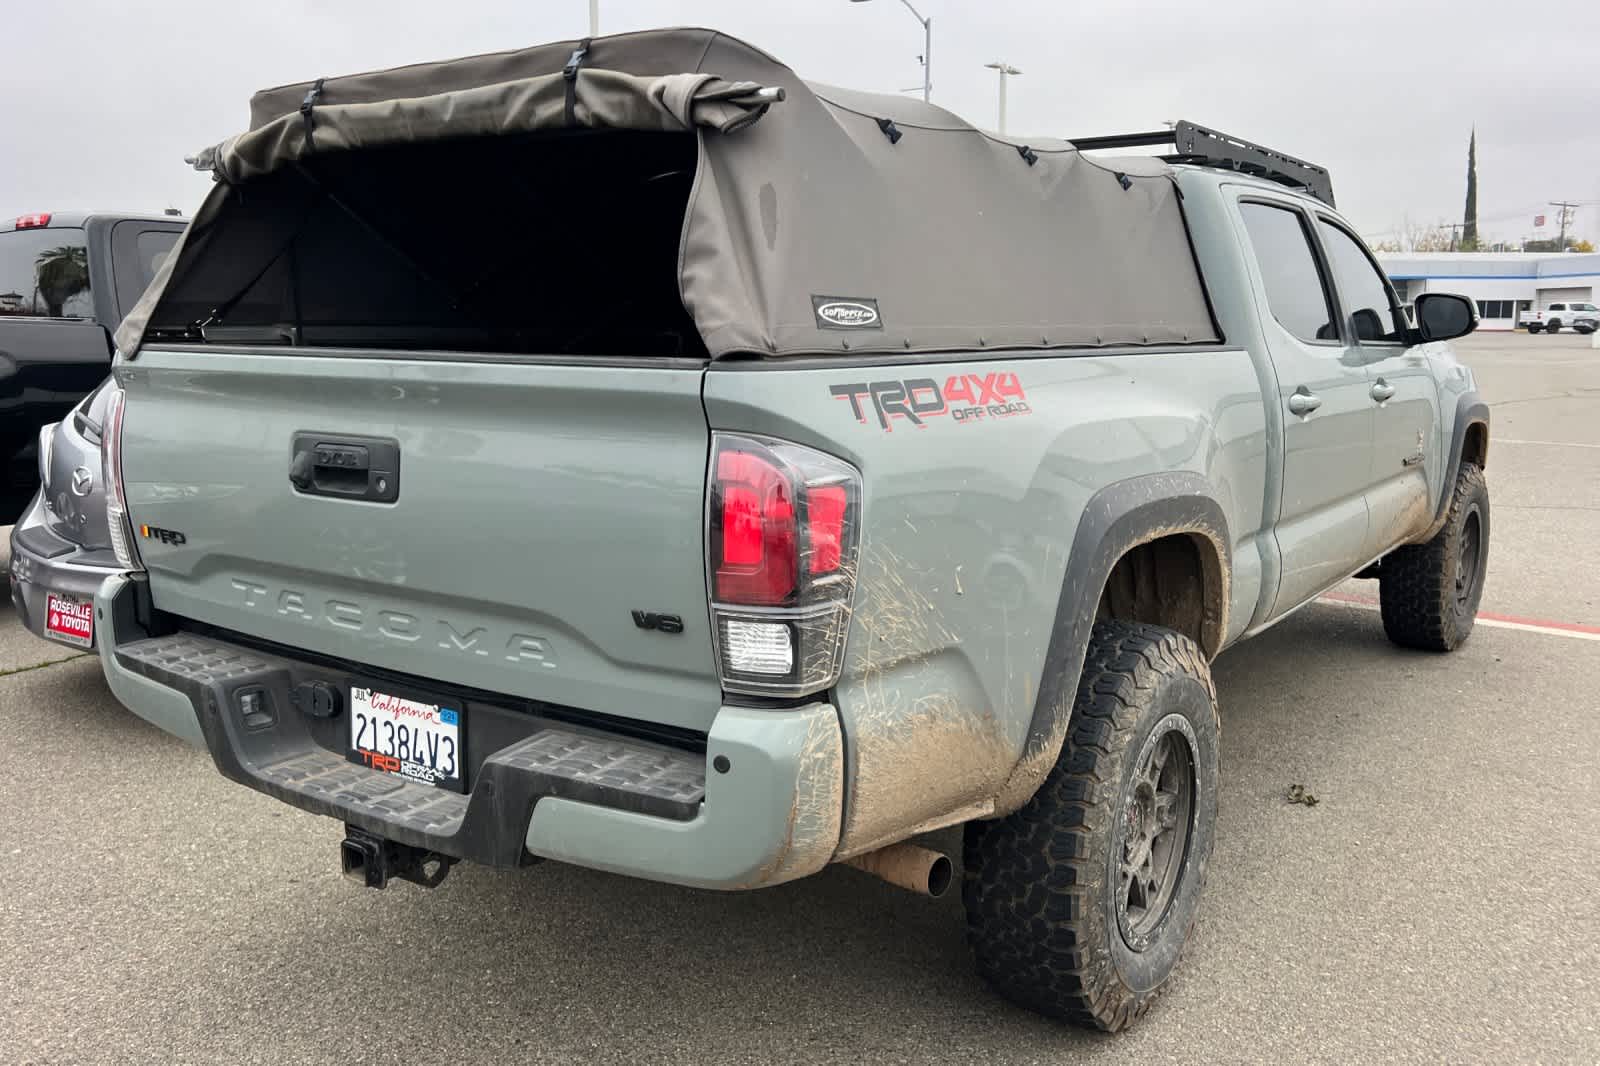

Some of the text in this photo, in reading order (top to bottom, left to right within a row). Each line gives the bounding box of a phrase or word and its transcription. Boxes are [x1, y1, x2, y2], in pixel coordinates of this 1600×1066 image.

[829, 378, 947, 432] TRD
[952, 401, 1031, 423] OFF ROAD
[147, 526, 187, 547] TRD
[51, 599, 91, 620] ROSEVILLE
[61, 614, 90, 633] TOYOTA
[232, 578, 556, 668] TACOMA
[631, 610, 684, 633] V6
[355, 689, 367, 701] JUL
[371, 691, 440, 725] California
[356, 713, 455, 776] 21384V3
[358, 748, 400, 774] TRD
